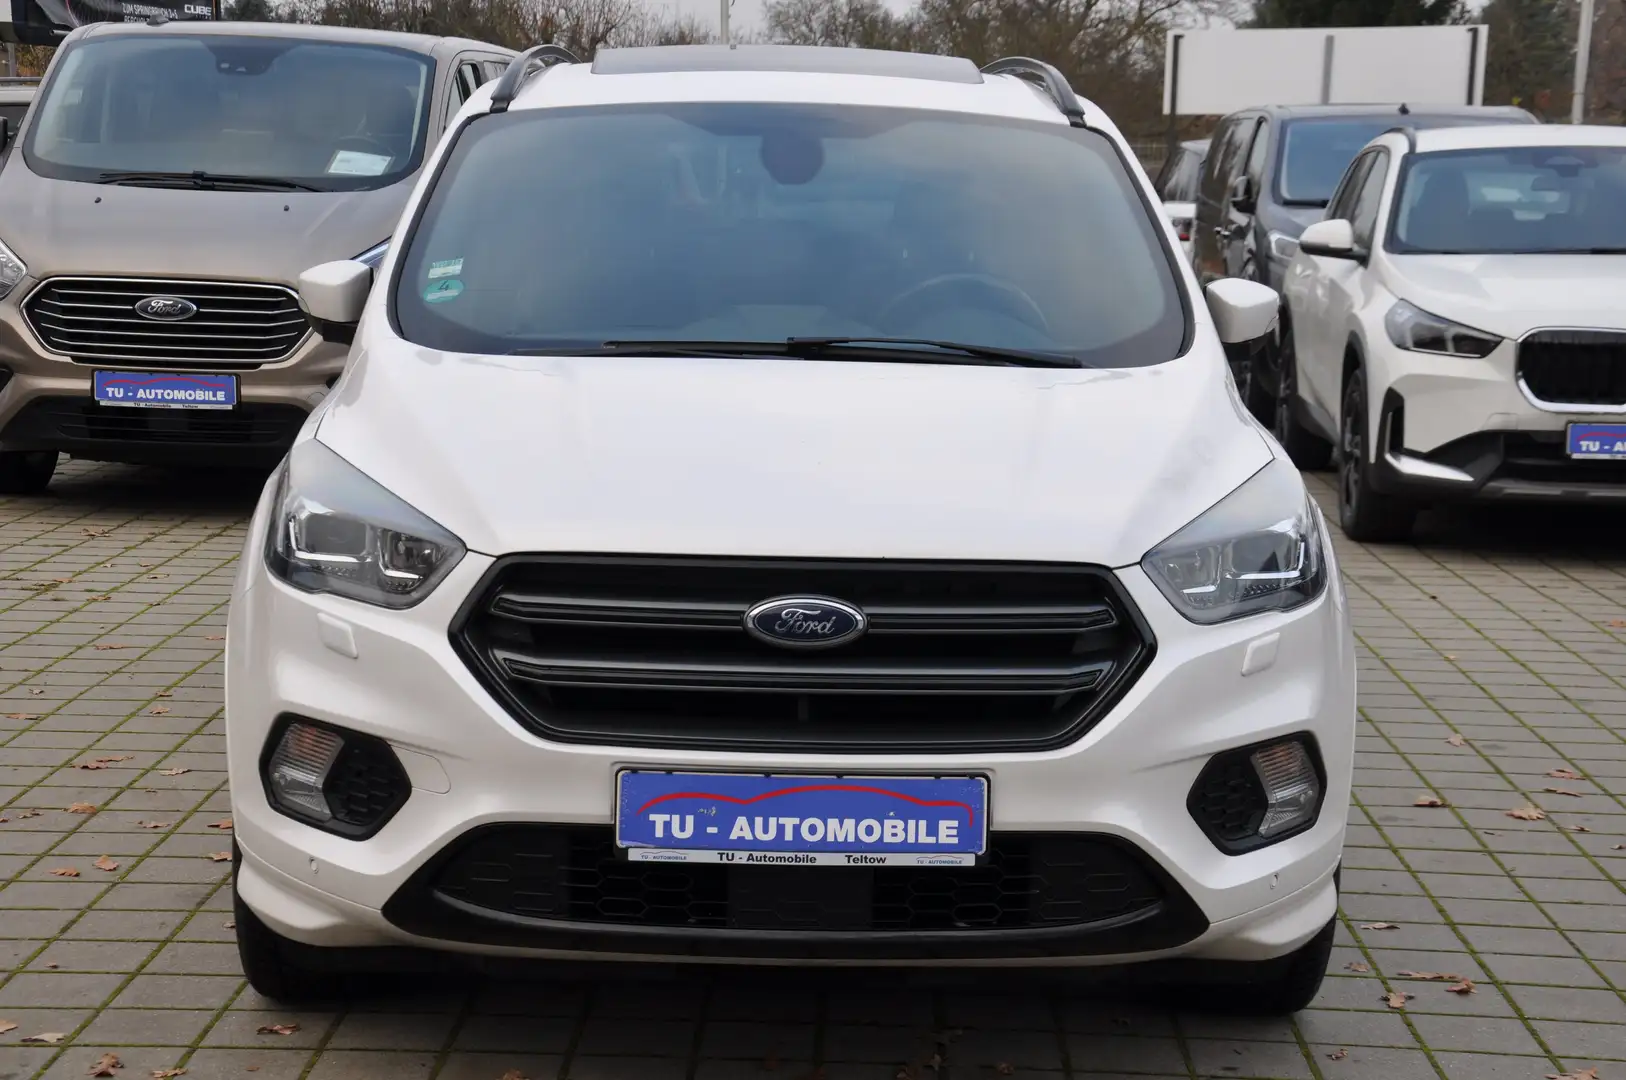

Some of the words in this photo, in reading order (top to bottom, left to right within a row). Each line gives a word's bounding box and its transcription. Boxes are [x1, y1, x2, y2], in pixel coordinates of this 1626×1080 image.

[184, 4, 212, 16] CUBE
[148, 300, 181, 314] Ford
[106, 387, 123, 398] TU
[136, 388, 225, 401] AUTOMOBILE
[1579, 440, 1600, 452] TU
[775, 608, 836, 633] Ford
[649, 813, 694, 838] TU
[729, 816, 959, 844] AUTOMOBILE
[717, 852, 735, 862] TU
[746, 852, 817, 864] Automobile
[845, 854, 887, 864] Teltow
